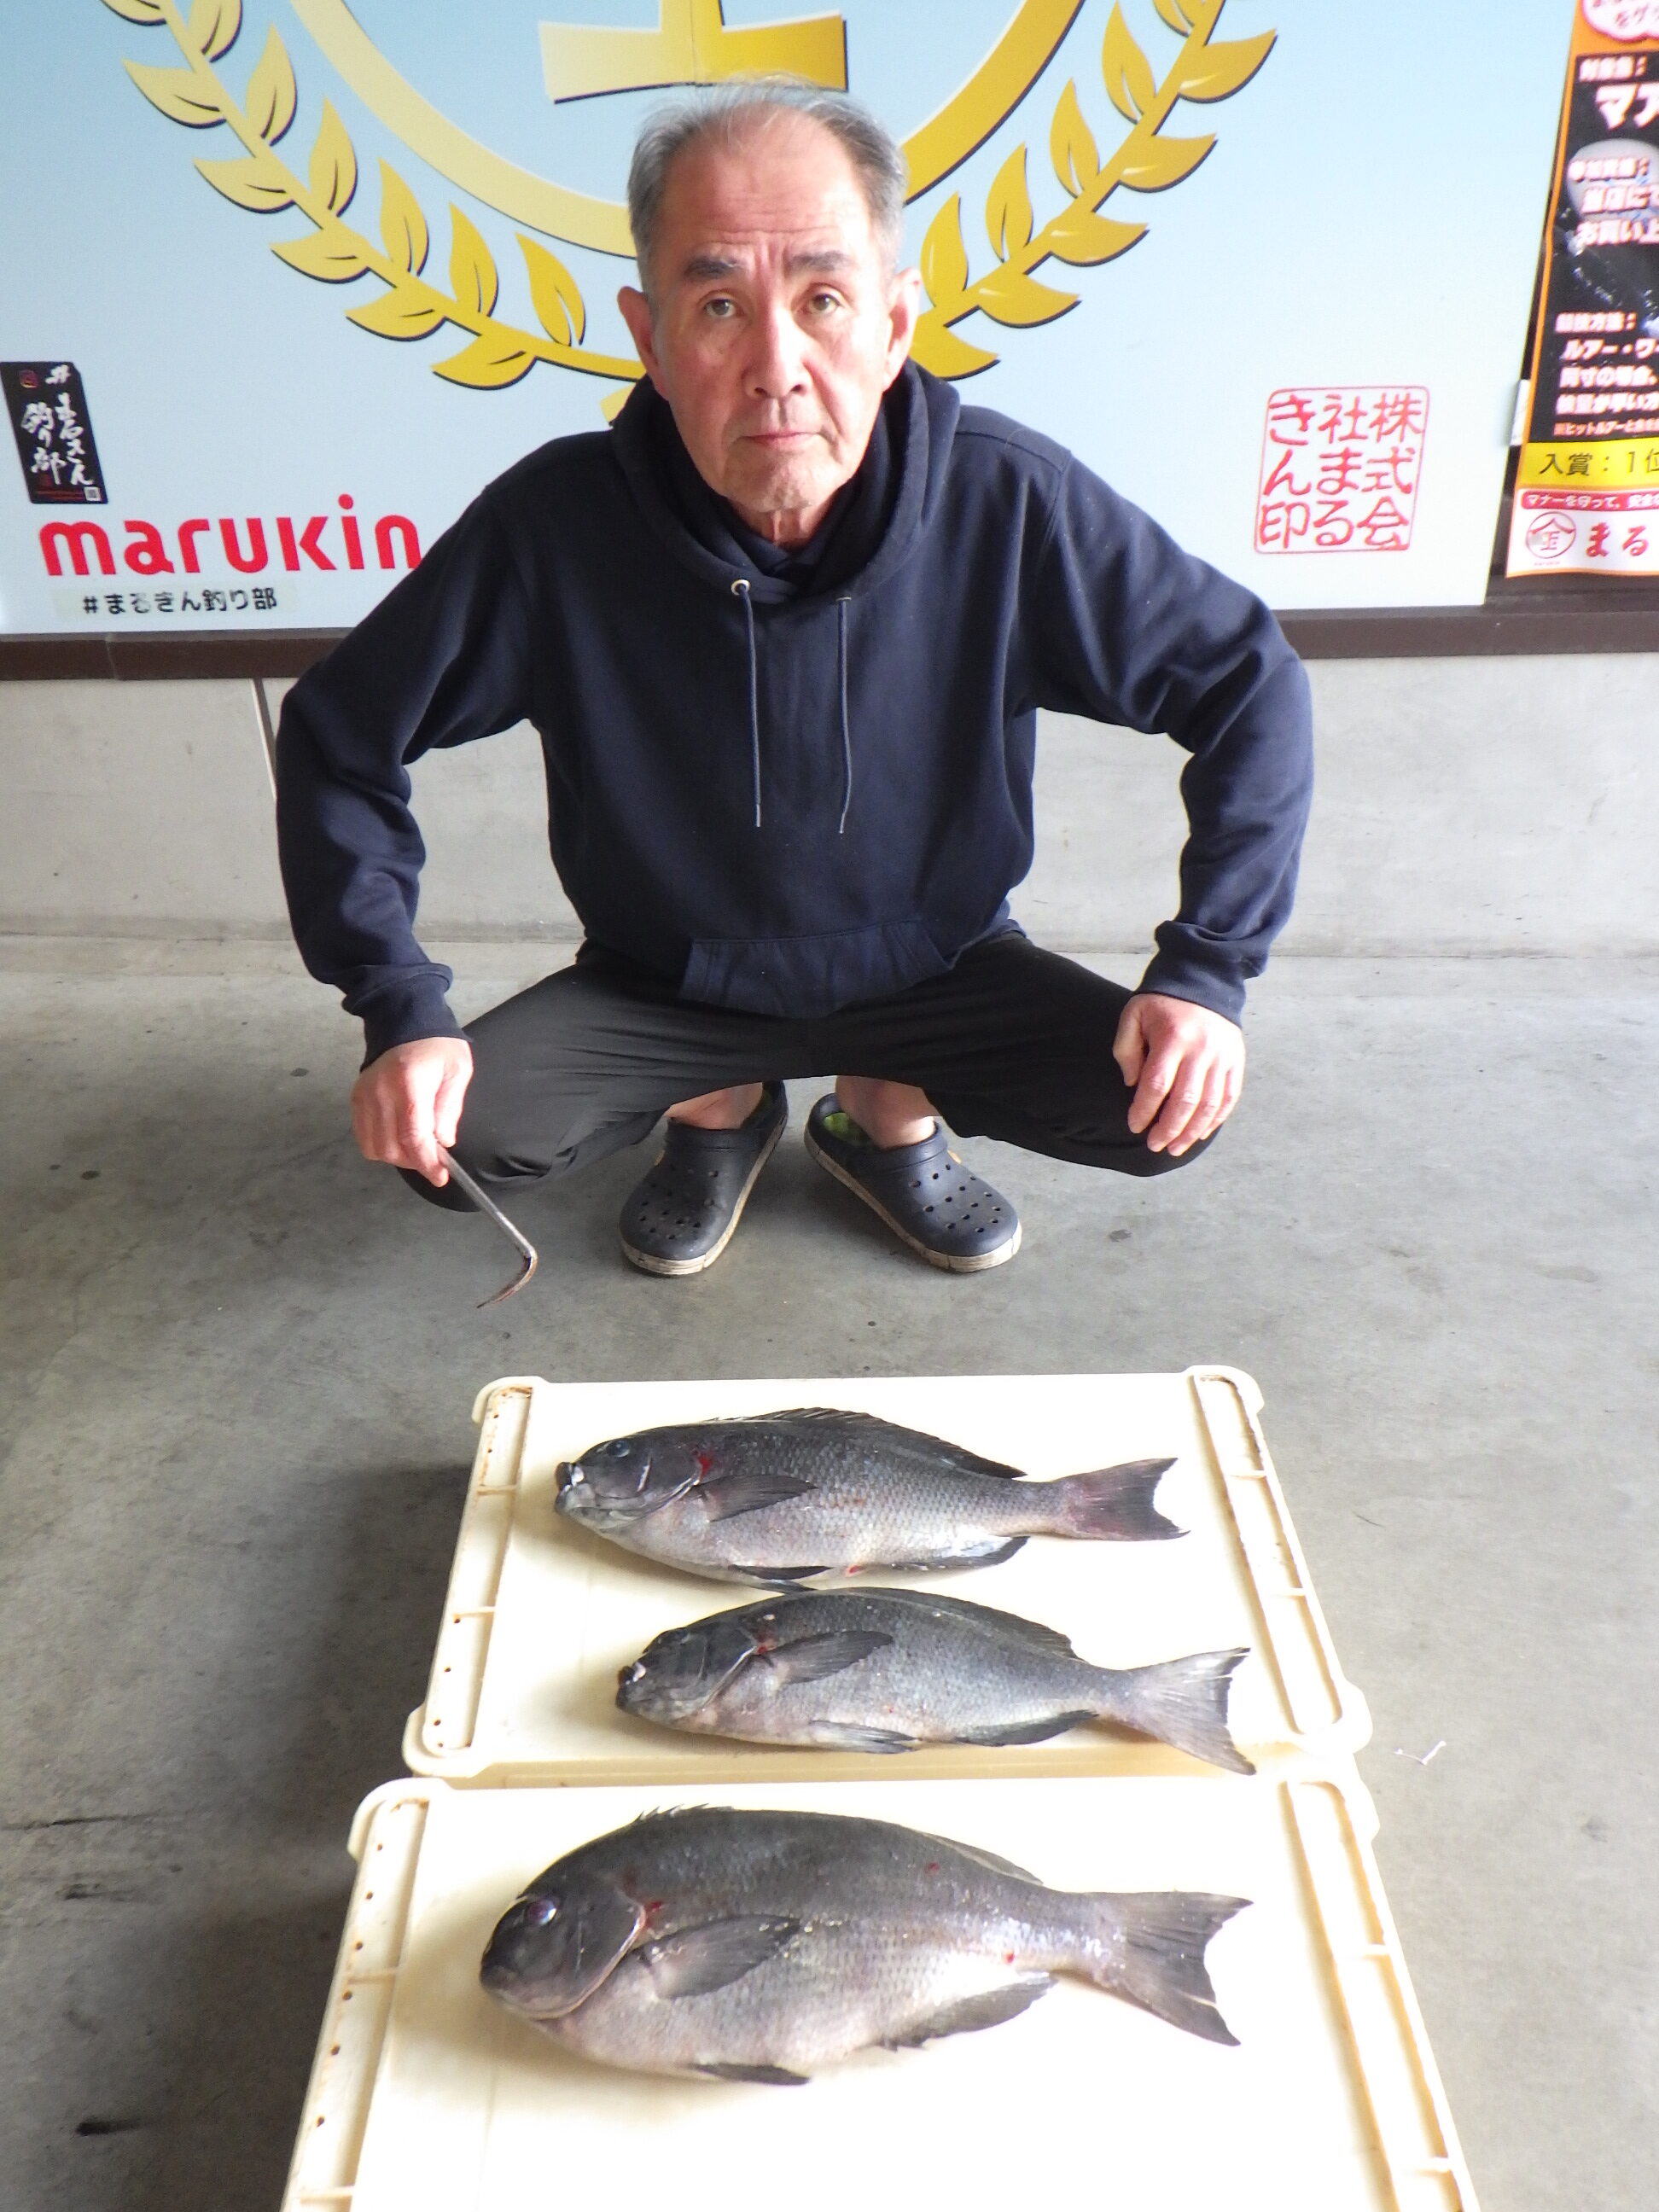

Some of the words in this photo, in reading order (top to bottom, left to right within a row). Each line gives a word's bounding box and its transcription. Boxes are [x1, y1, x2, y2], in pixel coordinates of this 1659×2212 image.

[1563, 338, 1659, 360] ルアー・ワ
[38, 493, 422, 576] marukin
[1585, 521, 1650, 558] まる
